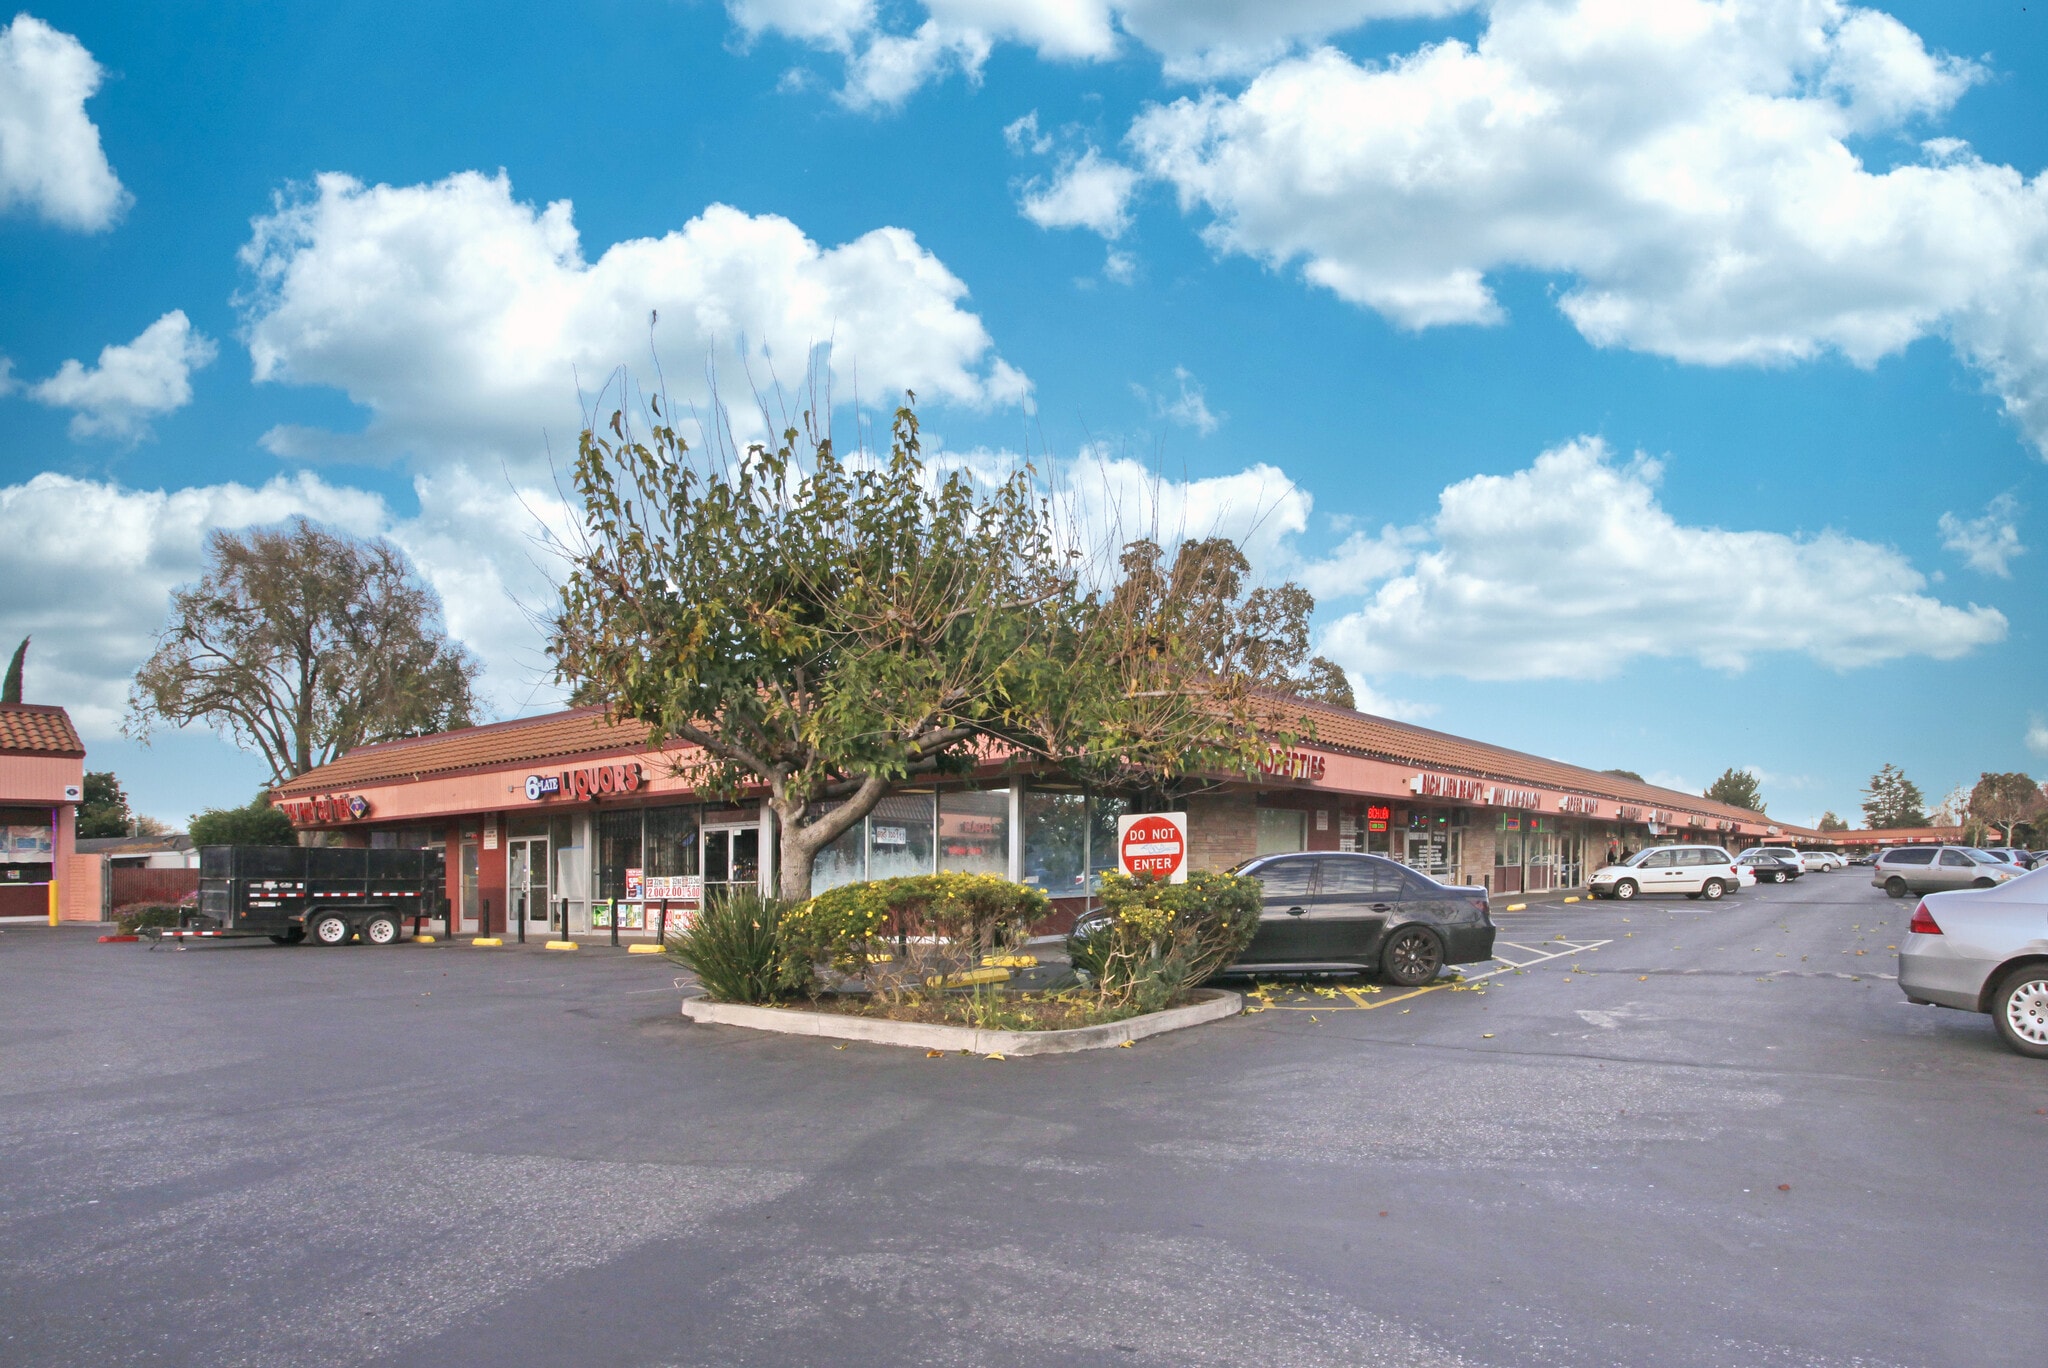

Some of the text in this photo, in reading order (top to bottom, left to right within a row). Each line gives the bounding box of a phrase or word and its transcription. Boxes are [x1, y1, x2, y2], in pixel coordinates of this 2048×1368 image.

[560, 763, 642, 801] LIQUORS
[1459, 778, 1485, 801] BEAUTY
[1130, 828, 1175, 841] DO NOT
[1134, 858, 1172, 870] ENTER
[648, 887, 664, 898] 2.00
[665, 887, 682, 897] 2.00
